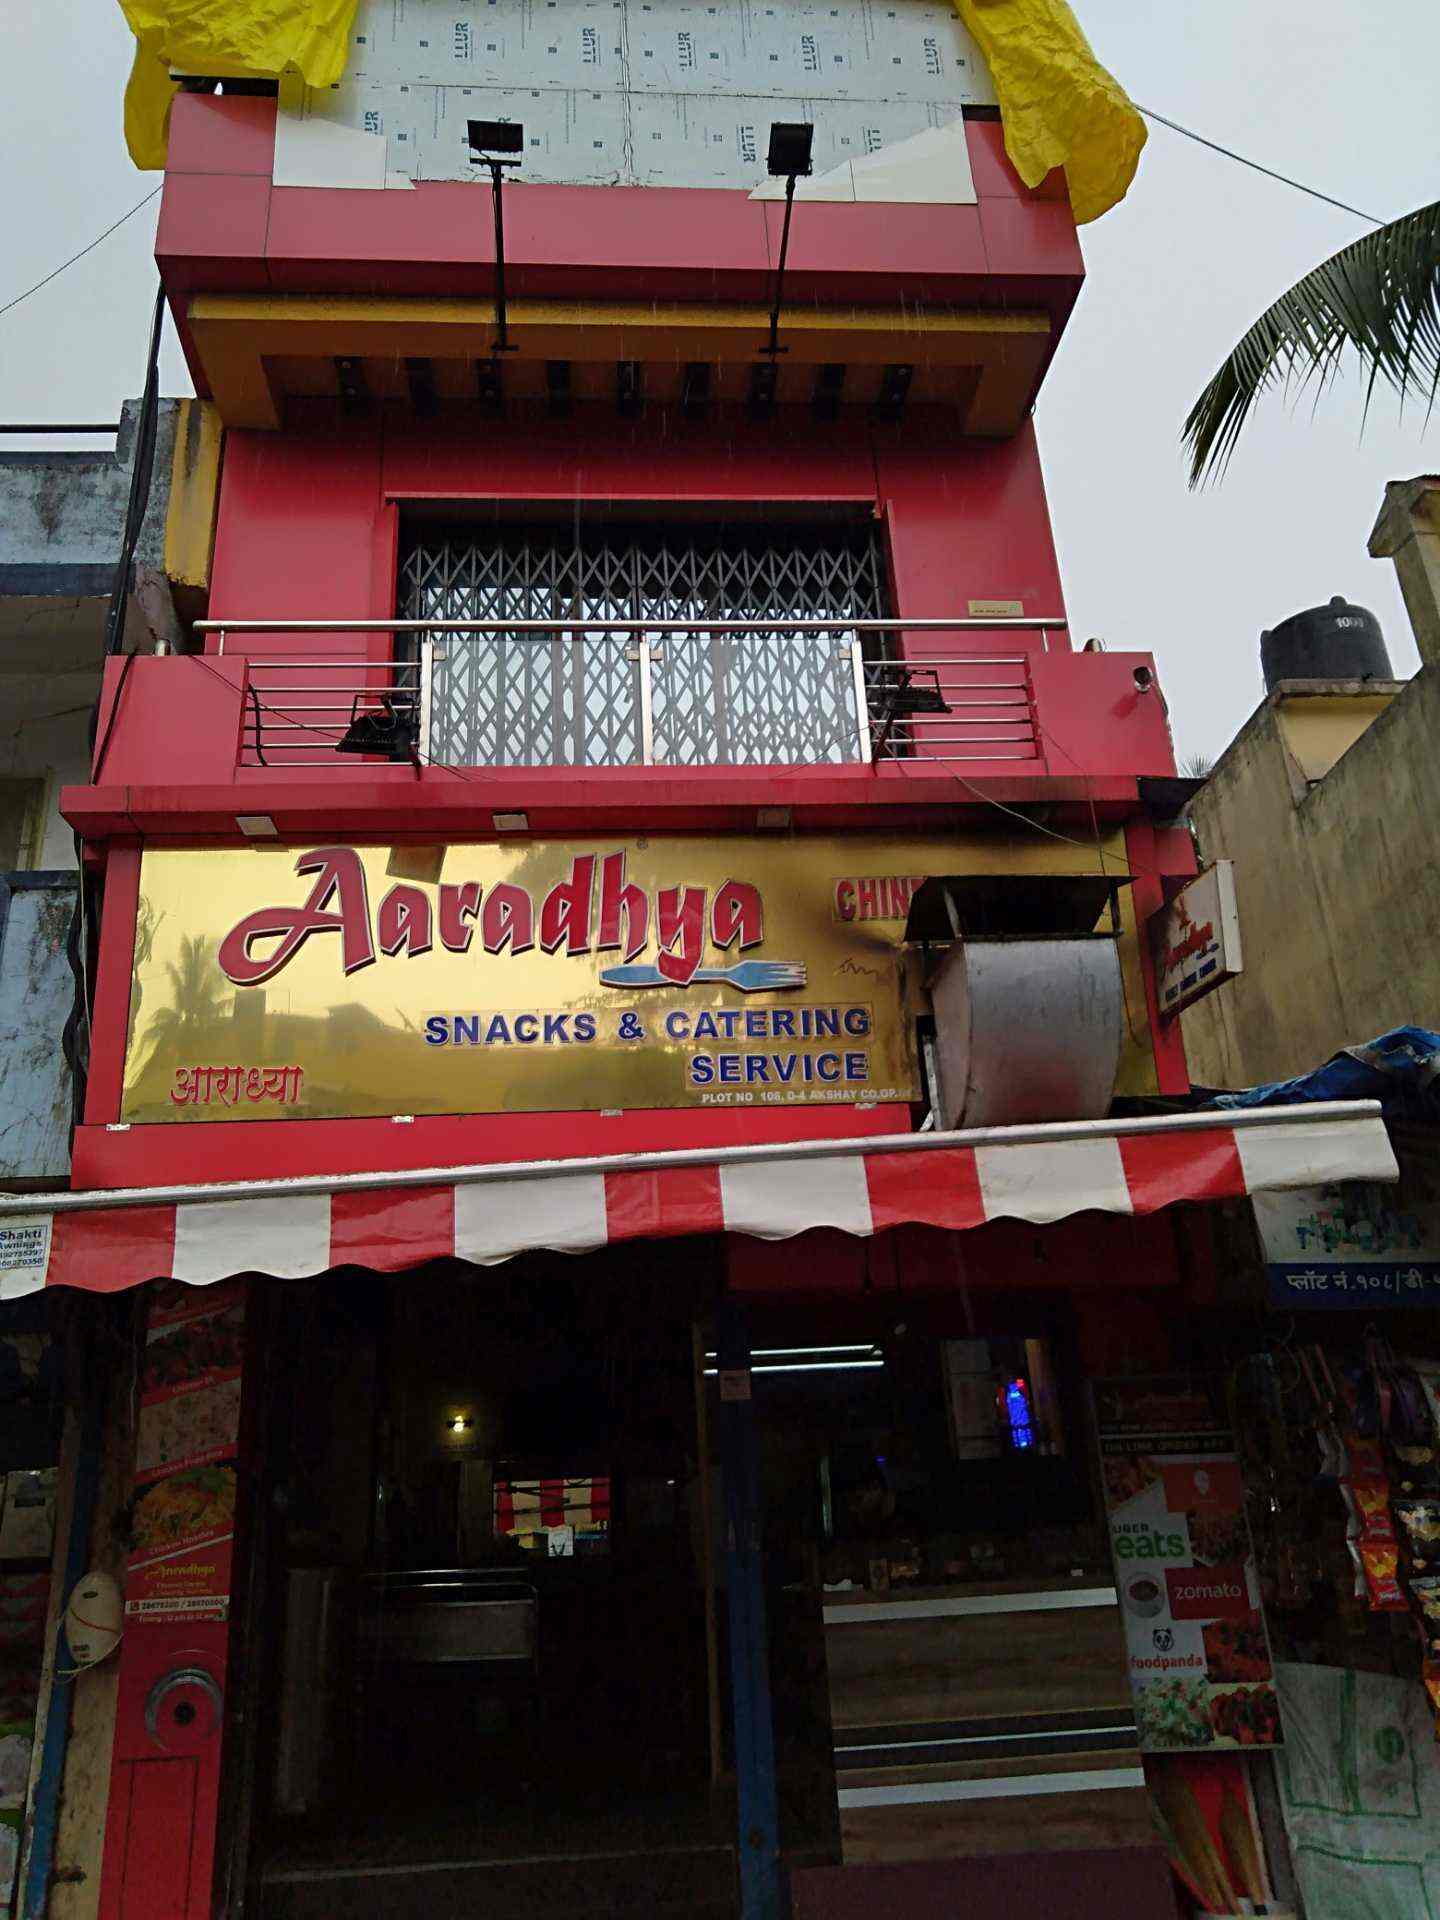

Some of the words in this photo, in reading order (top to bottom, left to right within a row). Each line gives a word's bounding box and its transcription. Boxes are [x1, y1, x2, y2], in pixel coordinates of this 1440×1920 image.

[217, 847, 764, 987] Aaradhya
[424, 1013, 597, 1046] SNACKS
[618, 1010, 645, 1041] &
[666, 1006, 872, 1041] CATERING
[691, 1052, 869, 1086] SERVICE
[170, 1066, 303, 1106] आराध्या
[702, 1093, 732, 1104] PLOT
[736, 1092, 753, 1103] NO
[809, 1089, 857, 1100] AKSHAY
[1286, 1270, 1328, 1290] प्लॉट
[1115, 1531, 1185, 1559] eats
[1175, 1583, 1242, 1600] zomato
[1130, 1654, 1204, 1671] foodpanda
